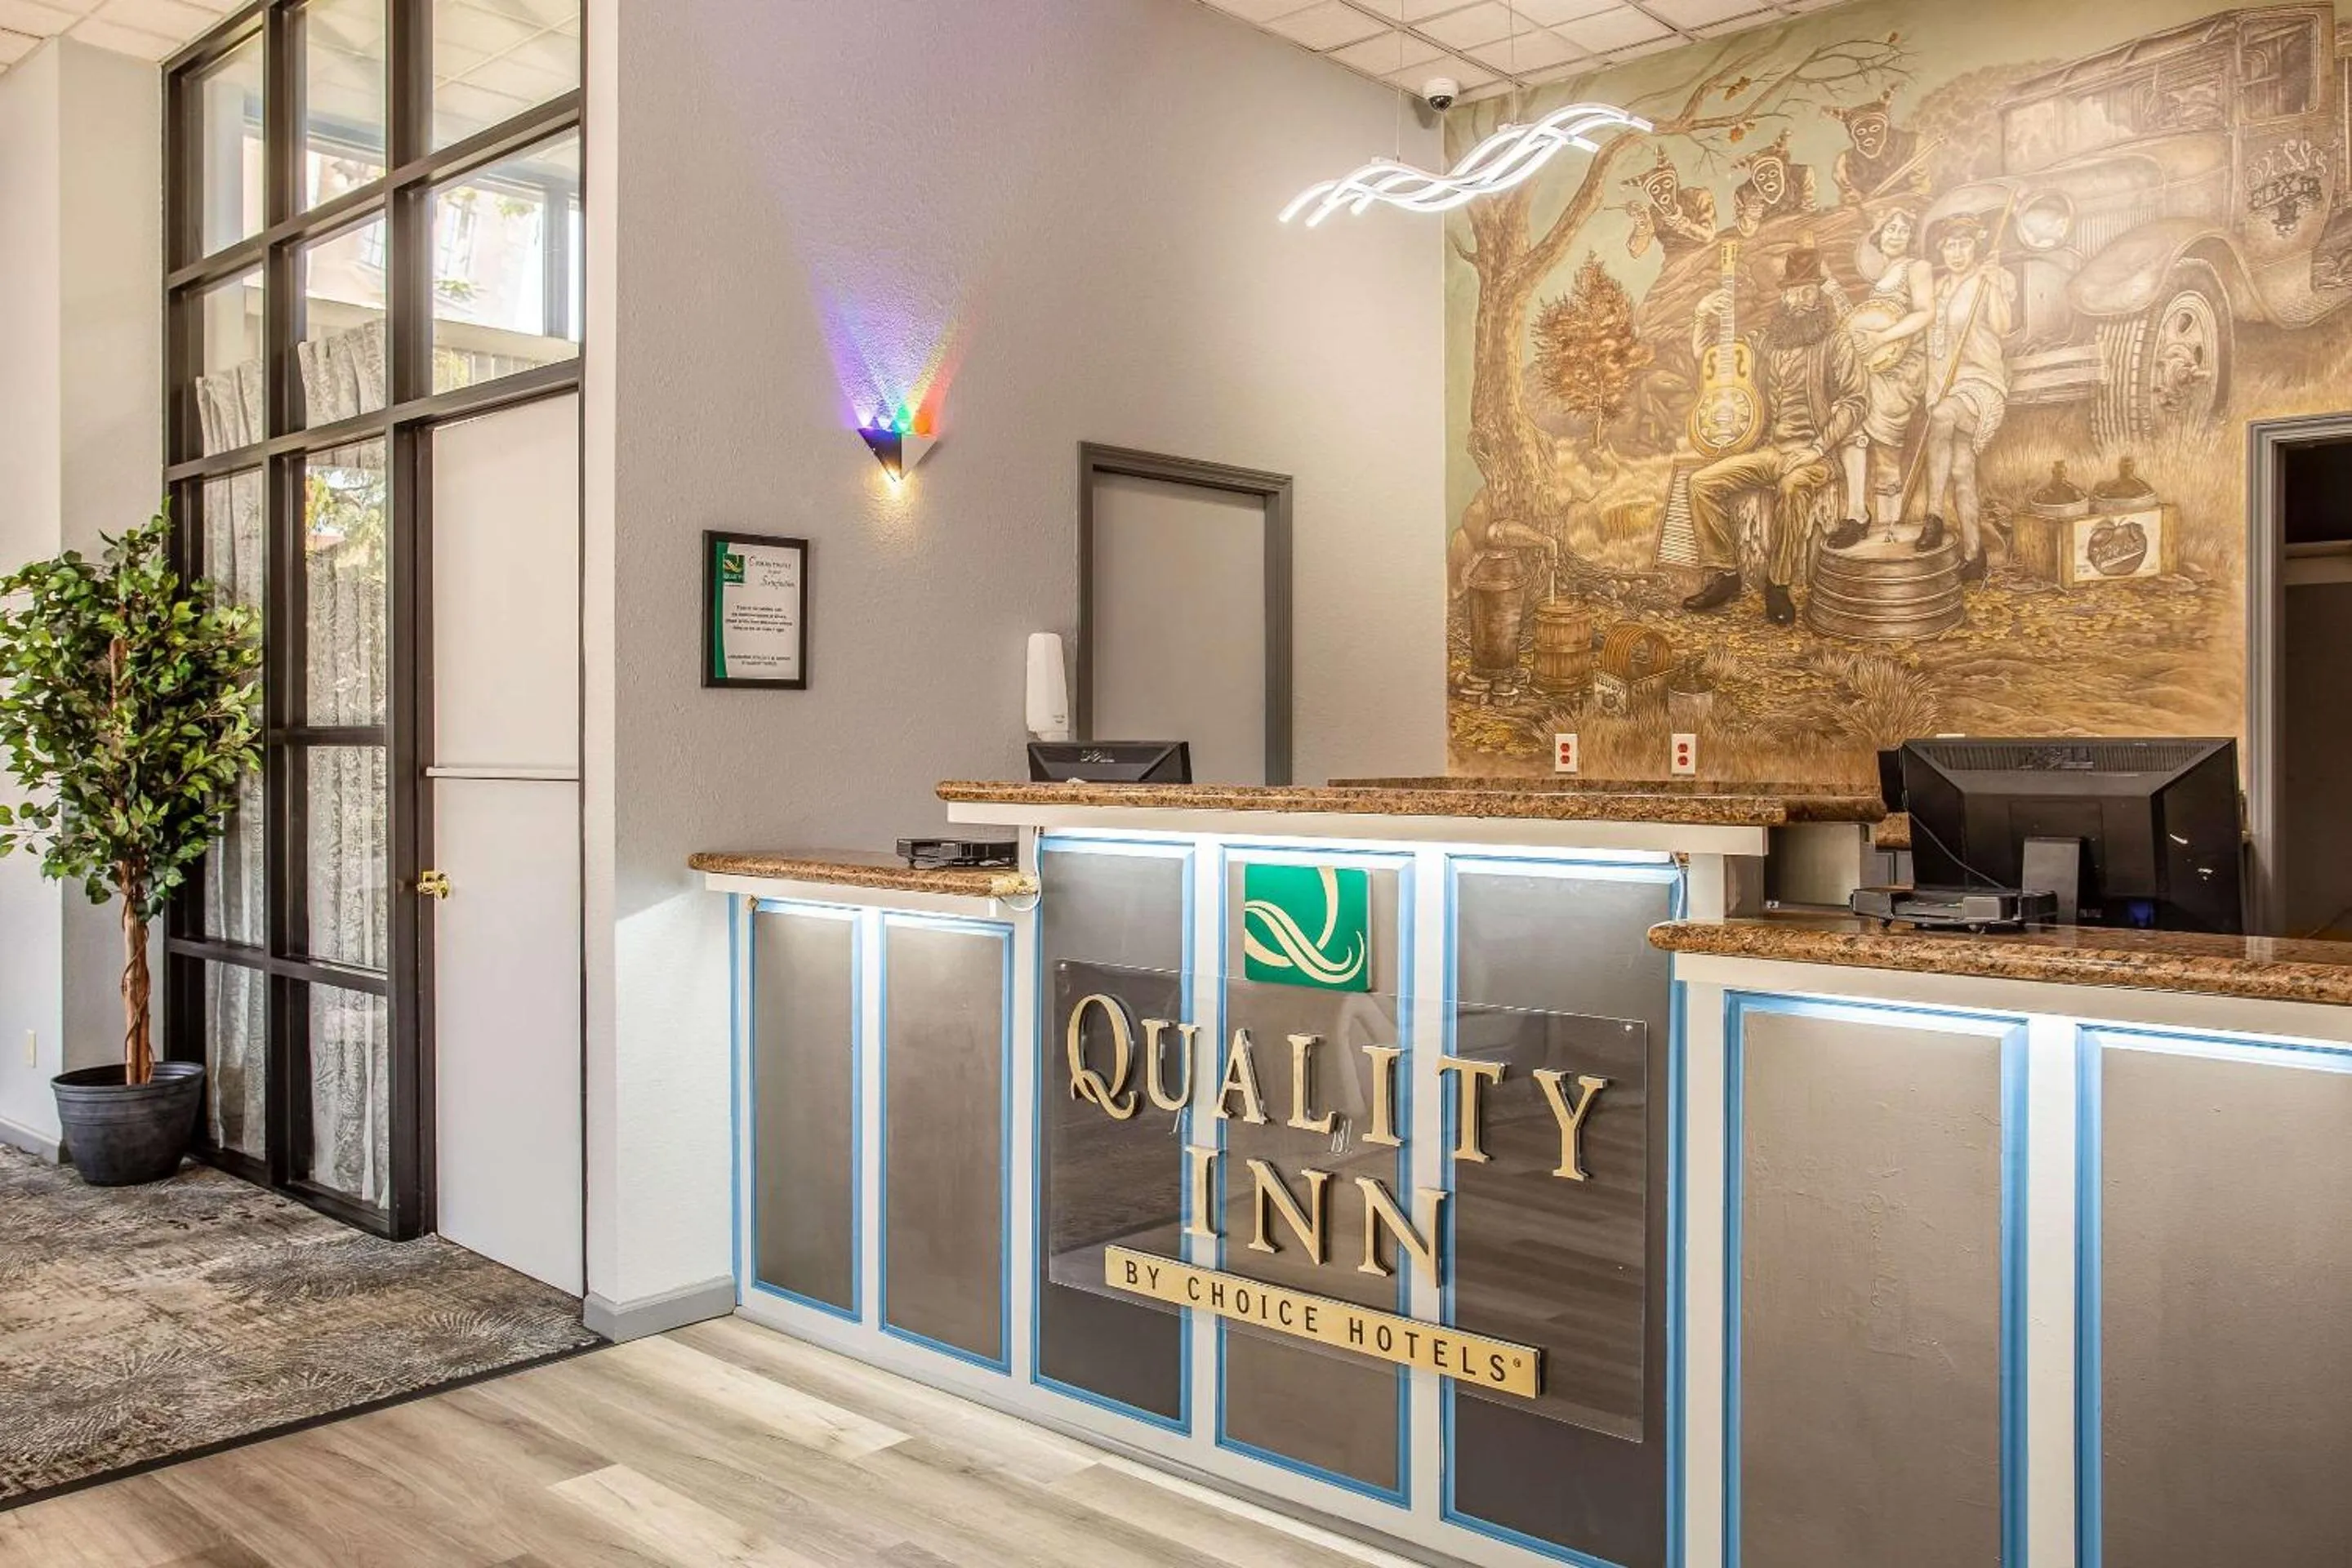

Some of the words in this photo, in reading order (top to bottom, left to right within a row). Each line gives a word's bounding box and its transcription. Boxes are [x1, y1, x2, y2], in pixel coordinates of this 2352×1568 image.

[1067, 992, 1607, 1181] QUALITY
[1184, 1143, 1450, 1288] INN
[1125, 1259, 1160, 1290] BY
[1187, 1276, 1318, 1333] CHOICE
